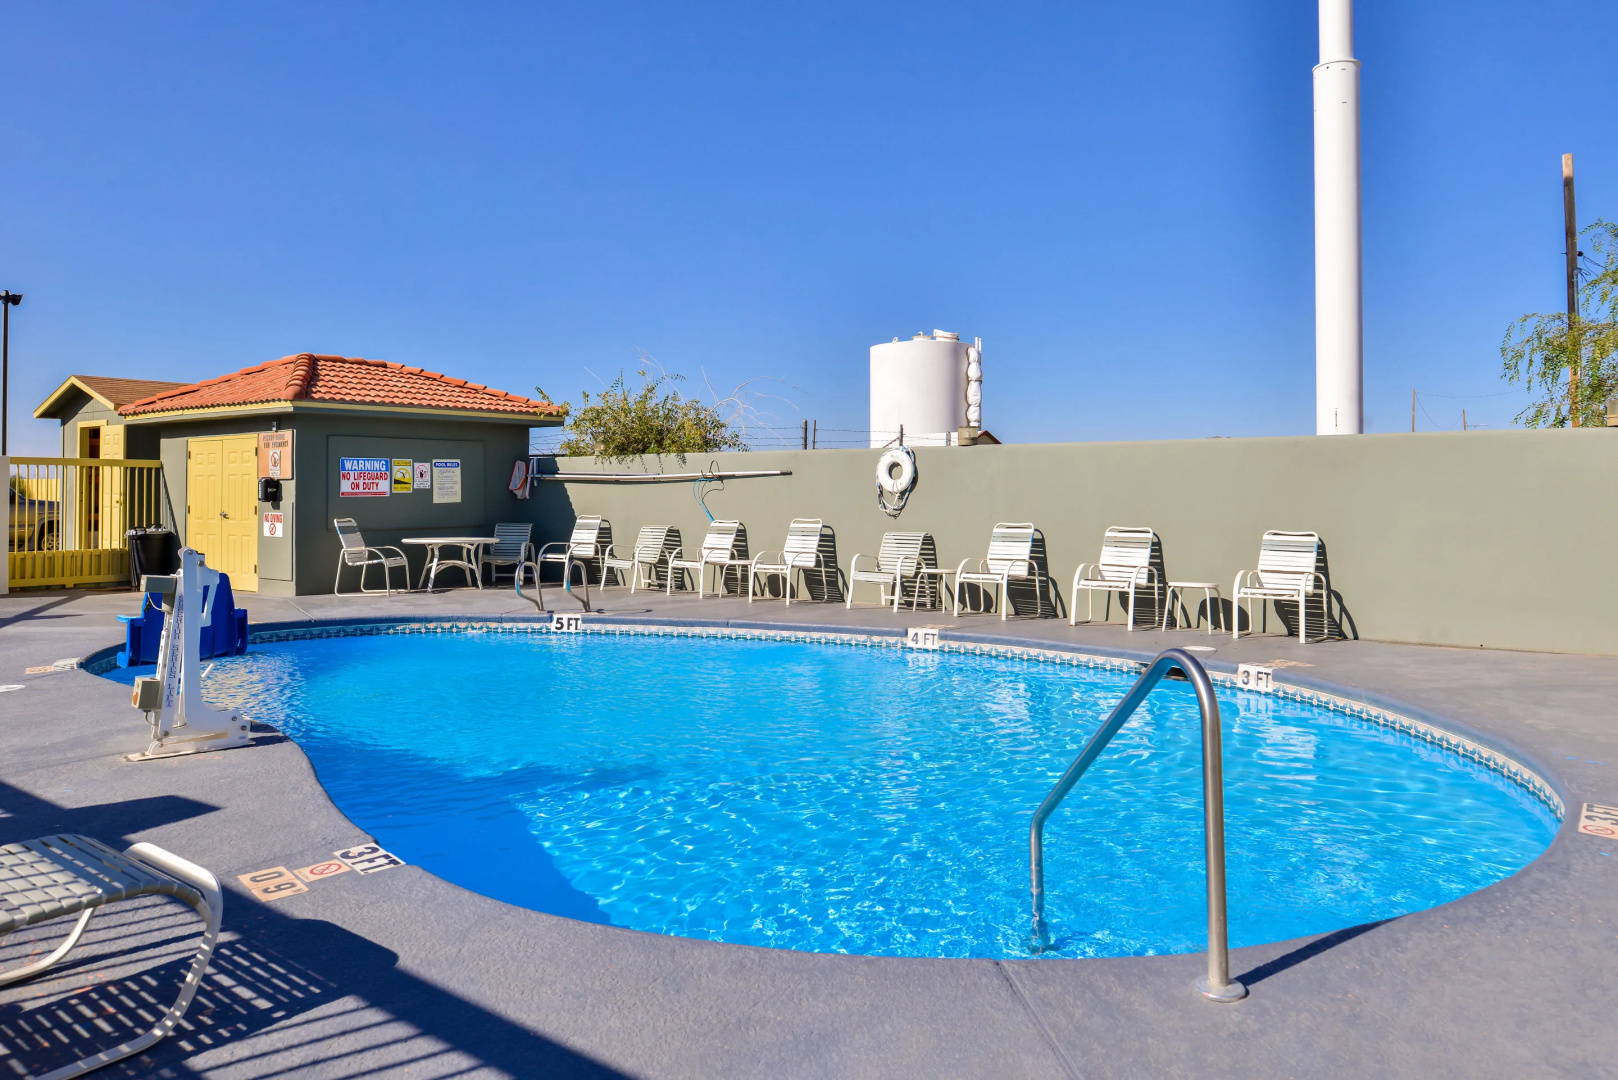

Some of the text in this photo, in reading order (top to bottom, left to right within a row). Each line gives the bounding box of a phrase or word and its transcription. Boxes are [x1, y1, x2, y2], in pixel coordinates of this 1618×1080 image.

[344, 460, 386, 470] WARNING
[341, 472, 389, 480] NO LIFEGUARD
[350, 481, 379, 490] ON DUTY
[264, 513, 283, 523] NO DIVING
[555, 617, 565, 631] 5
[911, 632, 937, 646] 4 FT
[168, 644, 179, 679] SERIES
[1241, 670, 1271, 688] 3 FT
[166, 683, 174, 707] LIFT
[340, 846, 402, 873] 3 FT
